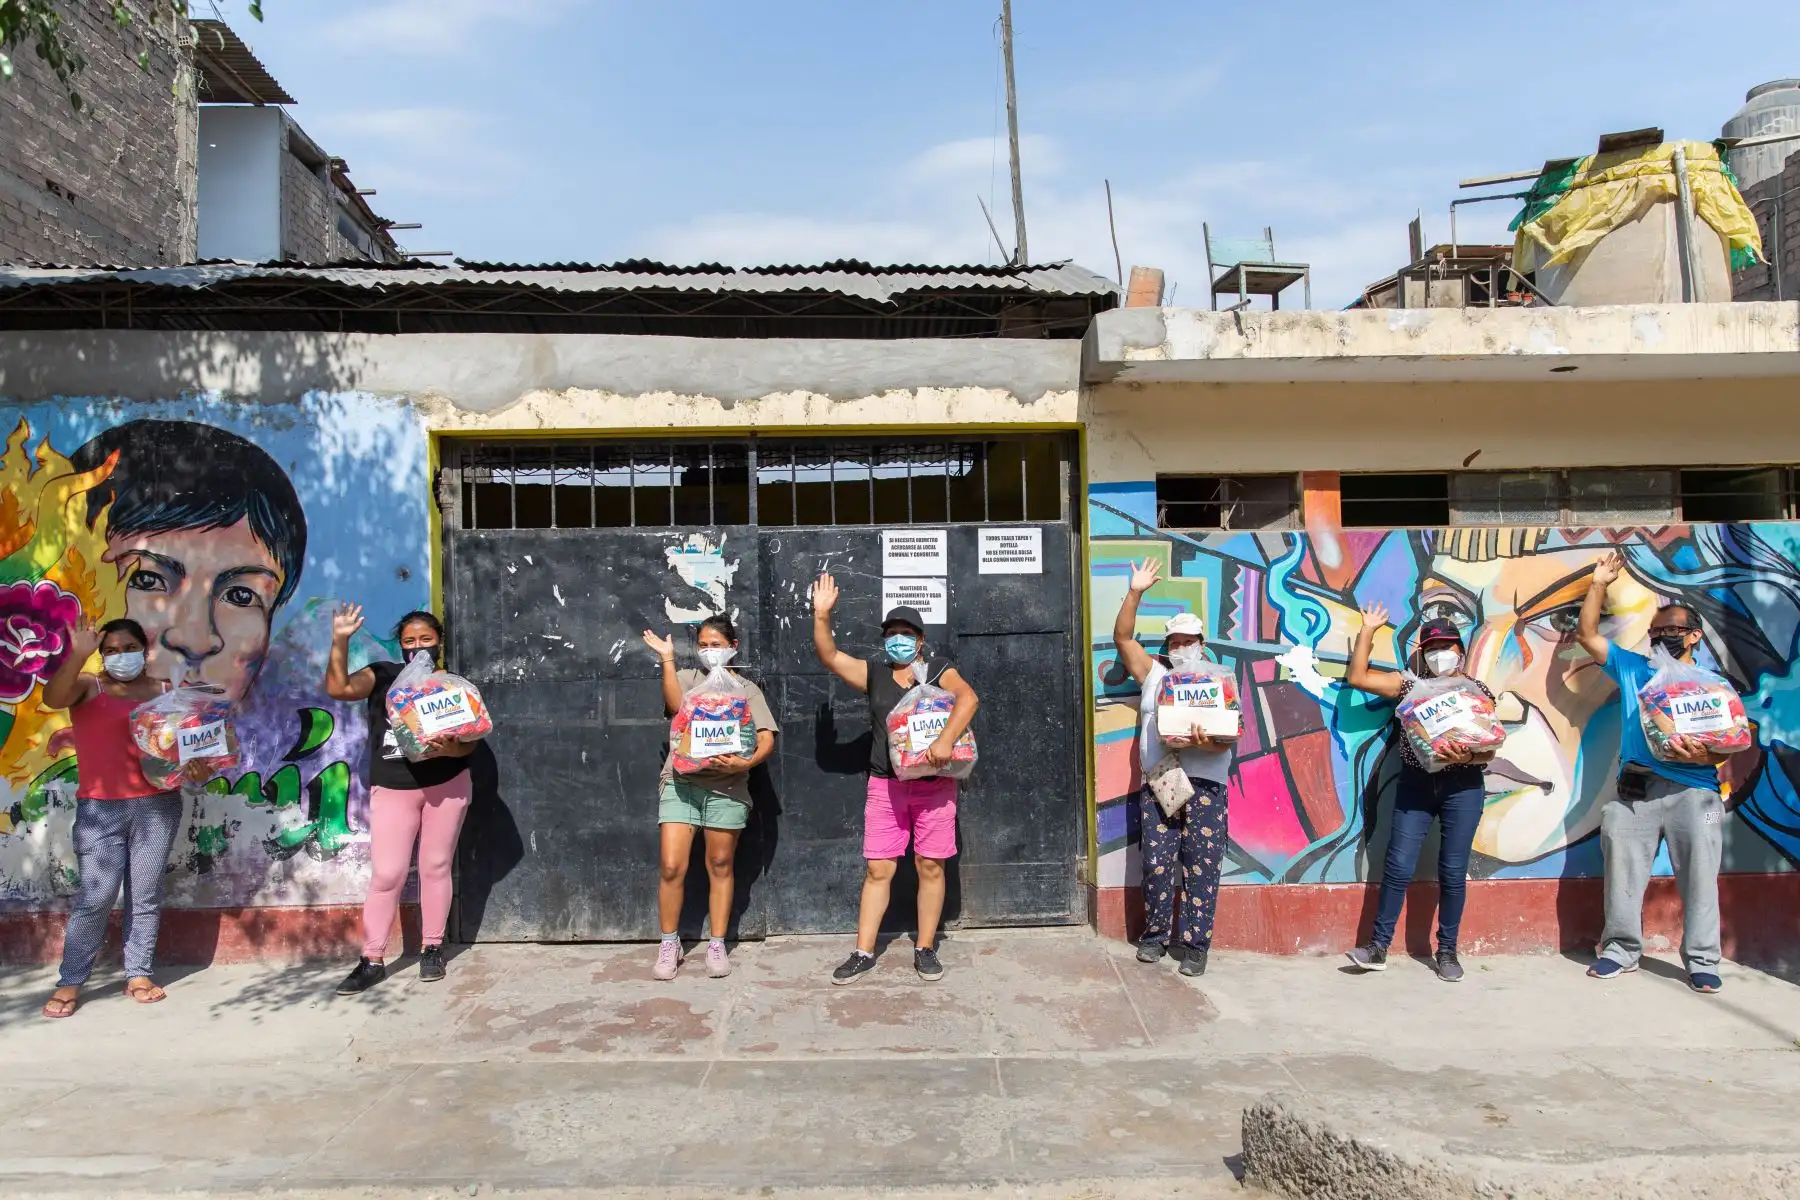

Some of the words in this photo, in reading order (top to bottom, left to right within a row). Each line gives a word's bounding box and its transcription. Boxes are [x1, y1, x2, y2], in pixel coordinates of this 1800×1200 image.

[1178, 689, 1209, 701] LIMA
[421, 697, 454, 715] LIMA
[1420, 700, 1451, 720] LIMA
[1675, 700, 1712, 714] LIMA
[912, 718, 943, 732] LIMA
[182, 730, 213, 746] LIMA
[695, 727, 725, 738] LIMA
